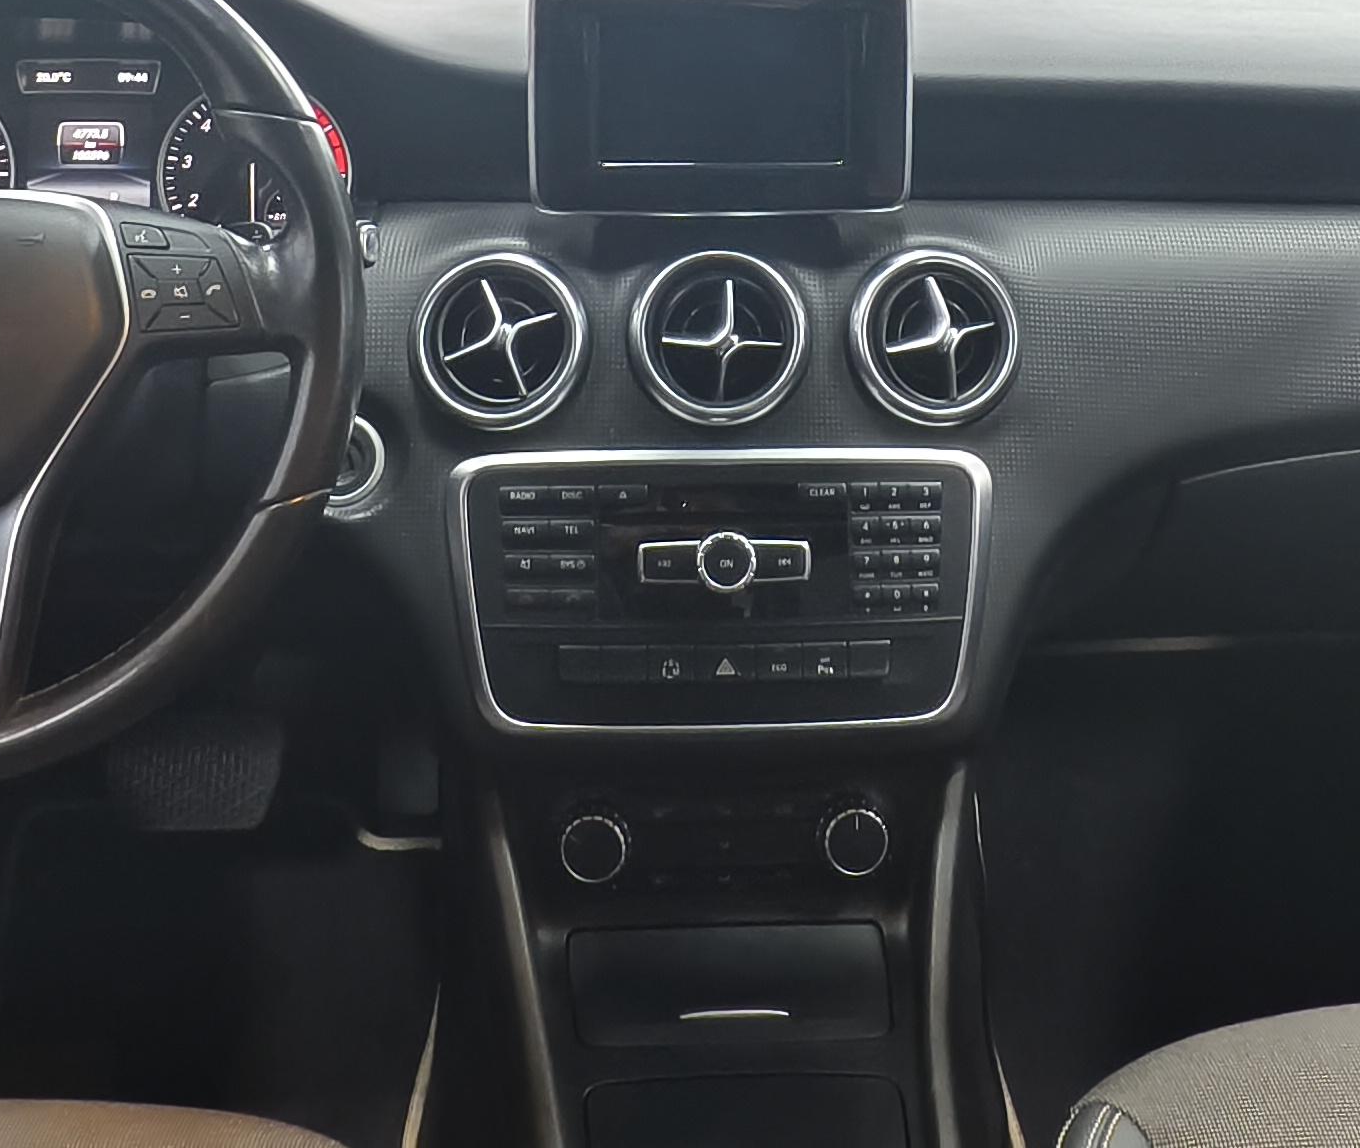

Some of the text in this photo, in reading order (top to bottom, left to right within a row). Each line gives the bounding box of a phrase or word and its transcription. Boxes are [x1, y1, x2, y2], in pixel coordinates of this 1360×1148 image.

[200, 118, 212, 132] 4
[181, 154, 193, 169] 3
[188, 193, 199, 207] 2
[509, 491, 536, 500] RADIO
[561, 491, 583, 500] DISC
[809, 488, 836, 497] CLEAR
[514, 526, 536, 535] NAVI
[564, 525, 579, 535] TEL
[719, 558, 735, 569] ON
